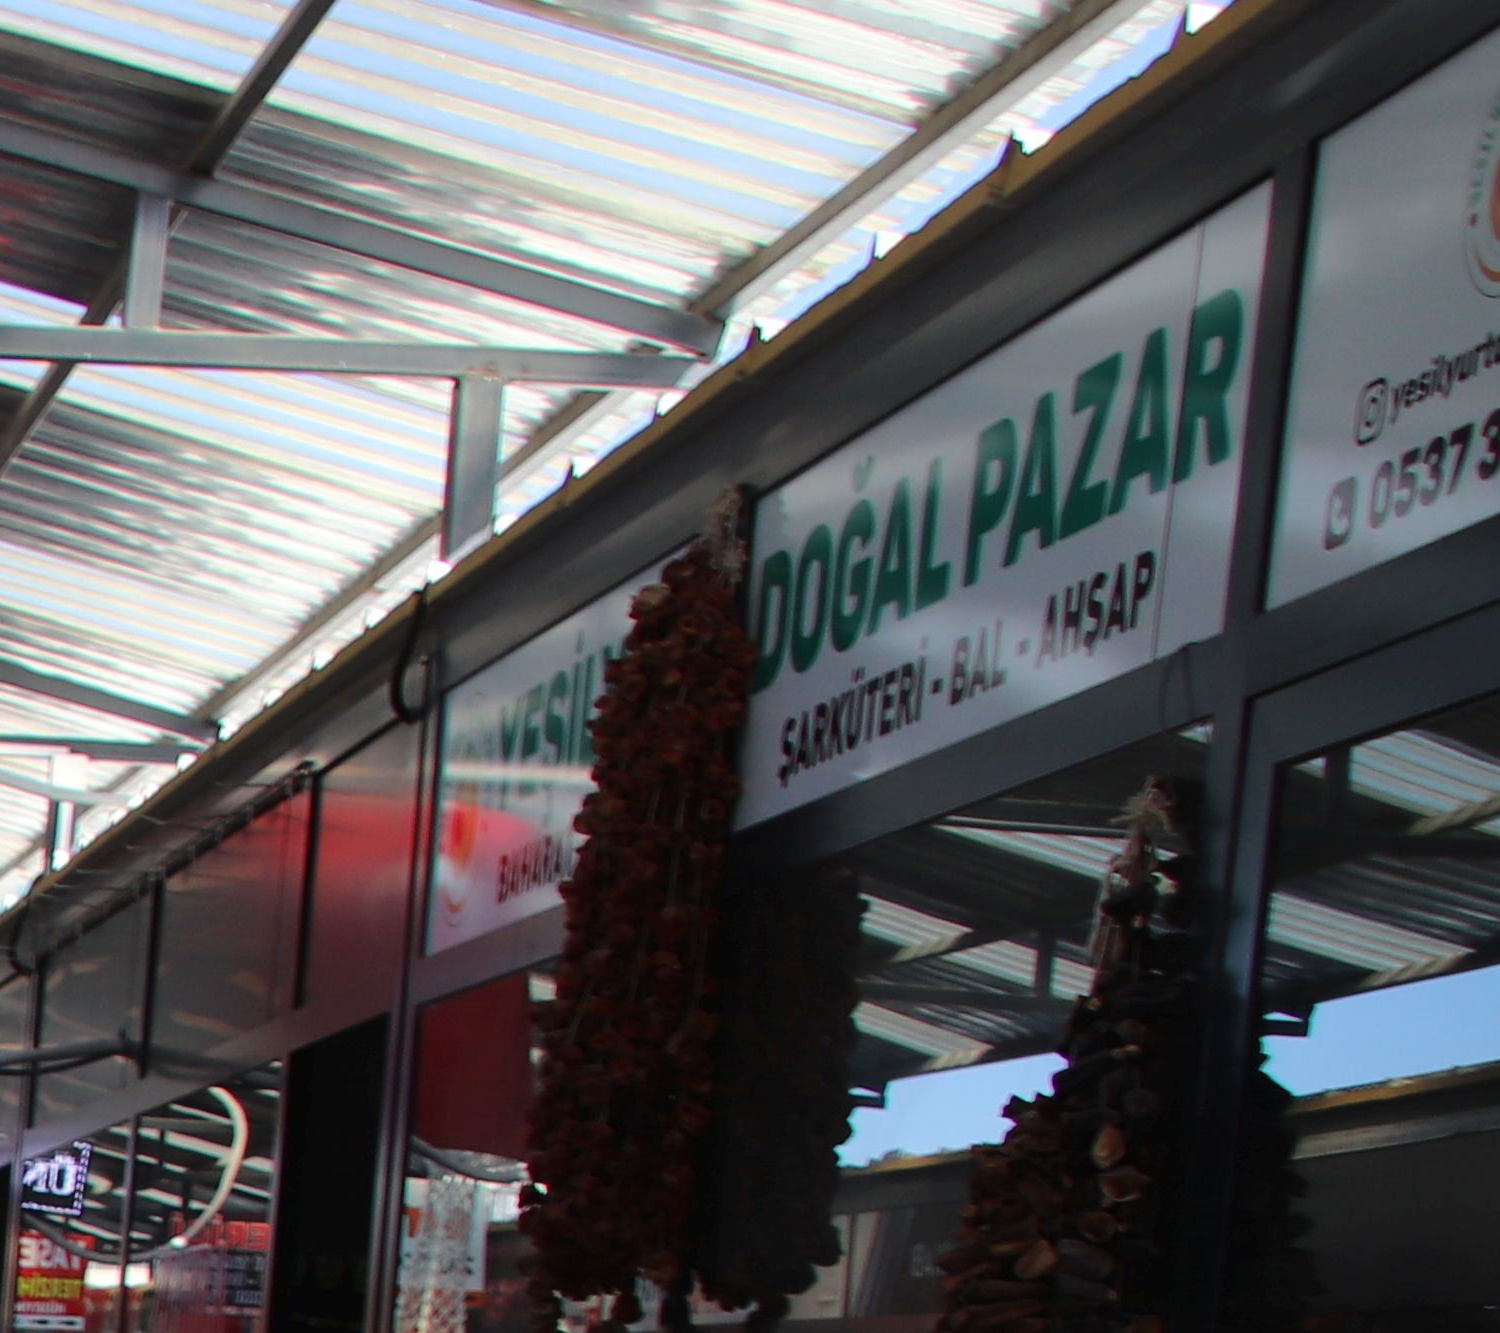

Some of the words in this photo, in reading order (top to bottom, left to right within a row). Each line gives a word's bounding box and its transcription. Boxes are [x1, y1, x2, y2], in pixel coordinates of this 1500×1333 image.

[754, 452, 954, 694] DOĞAL
[963, 287, 1244, 588] PAZAR
[949, 620, 1008, 708] BAL
[1035, 548, 1156, 668] AHŞAP
